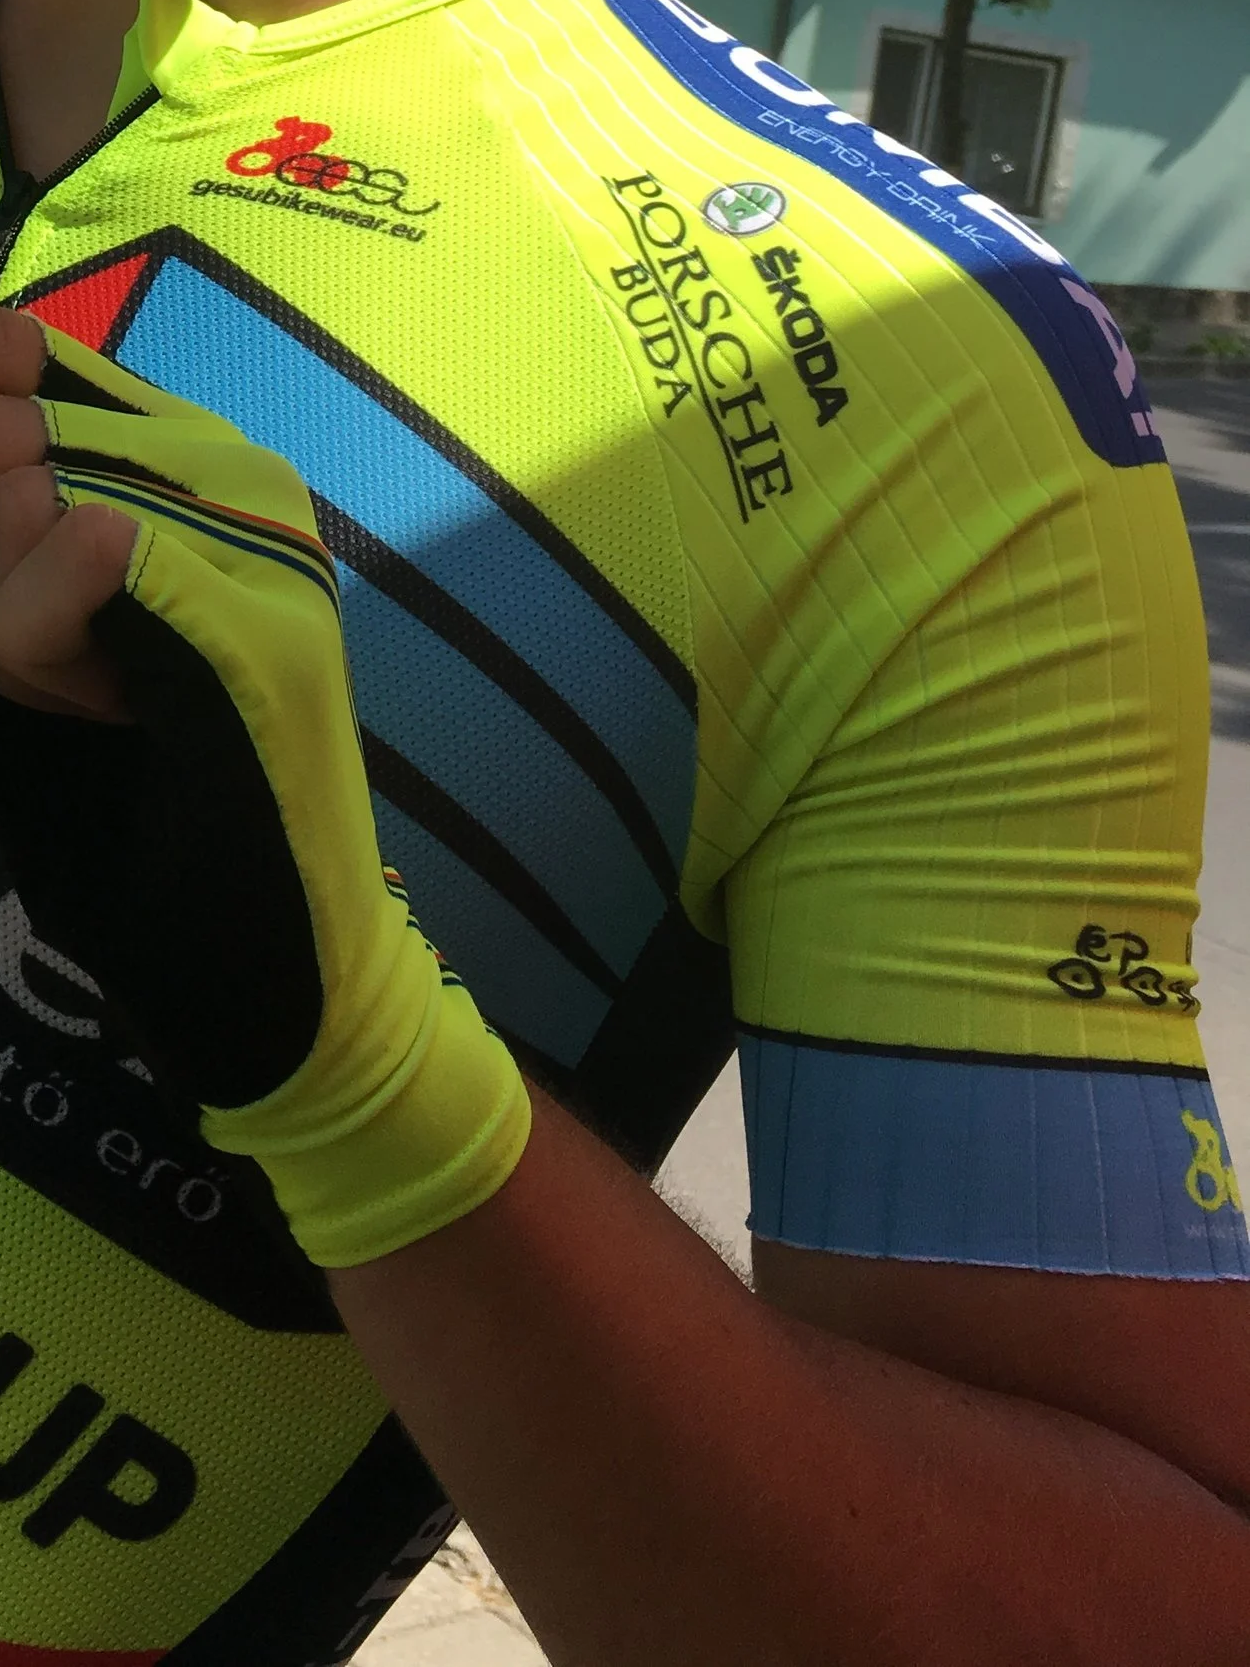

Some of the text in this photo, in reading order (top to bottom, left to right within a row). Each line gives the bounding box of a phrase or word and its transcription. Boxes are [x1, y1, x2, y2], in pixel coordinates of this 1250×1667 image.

[188, 177, 428, 243] gesubikewear.eu
[757, 109, 996, 250] ENERGY DRINK
[610, 258, 692, 419] BUDA
[612, 170, 794, 511] PORSCHE
[750, 245, 849, 428] ŠKODA
